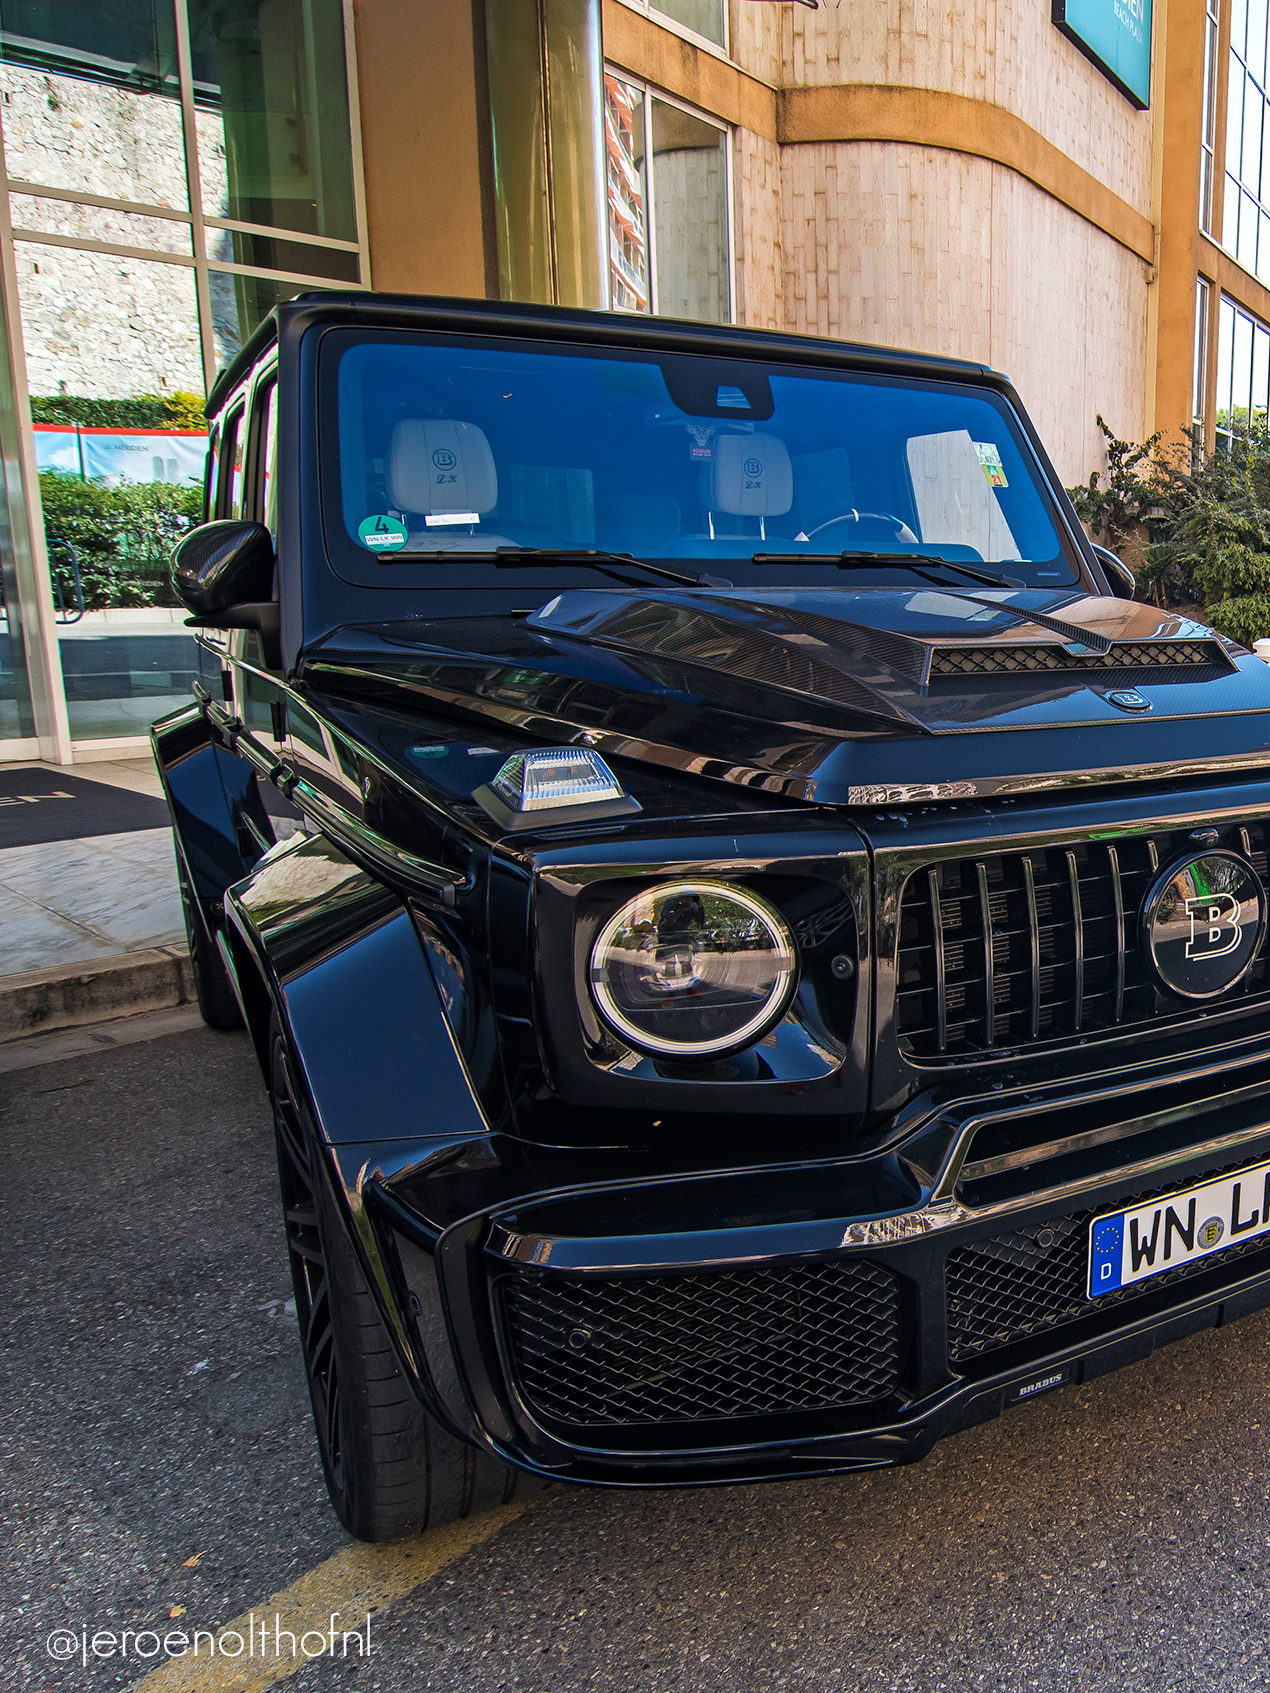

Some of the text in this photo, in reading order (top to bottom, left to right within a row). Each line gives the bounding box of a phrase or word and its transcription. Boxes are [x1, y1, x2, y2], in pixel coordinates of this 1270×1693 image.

[1113, 0, 1143, 46] BEACH PLAZA
[375, 516, 390, 533] 4
[1185, 893, 1242, 961] B
[1130, 1197, 1197, 1273] WN
[1101, 1262, 1112, 1280] D
[1019, 1373, 1062, 1396] BRABUS
